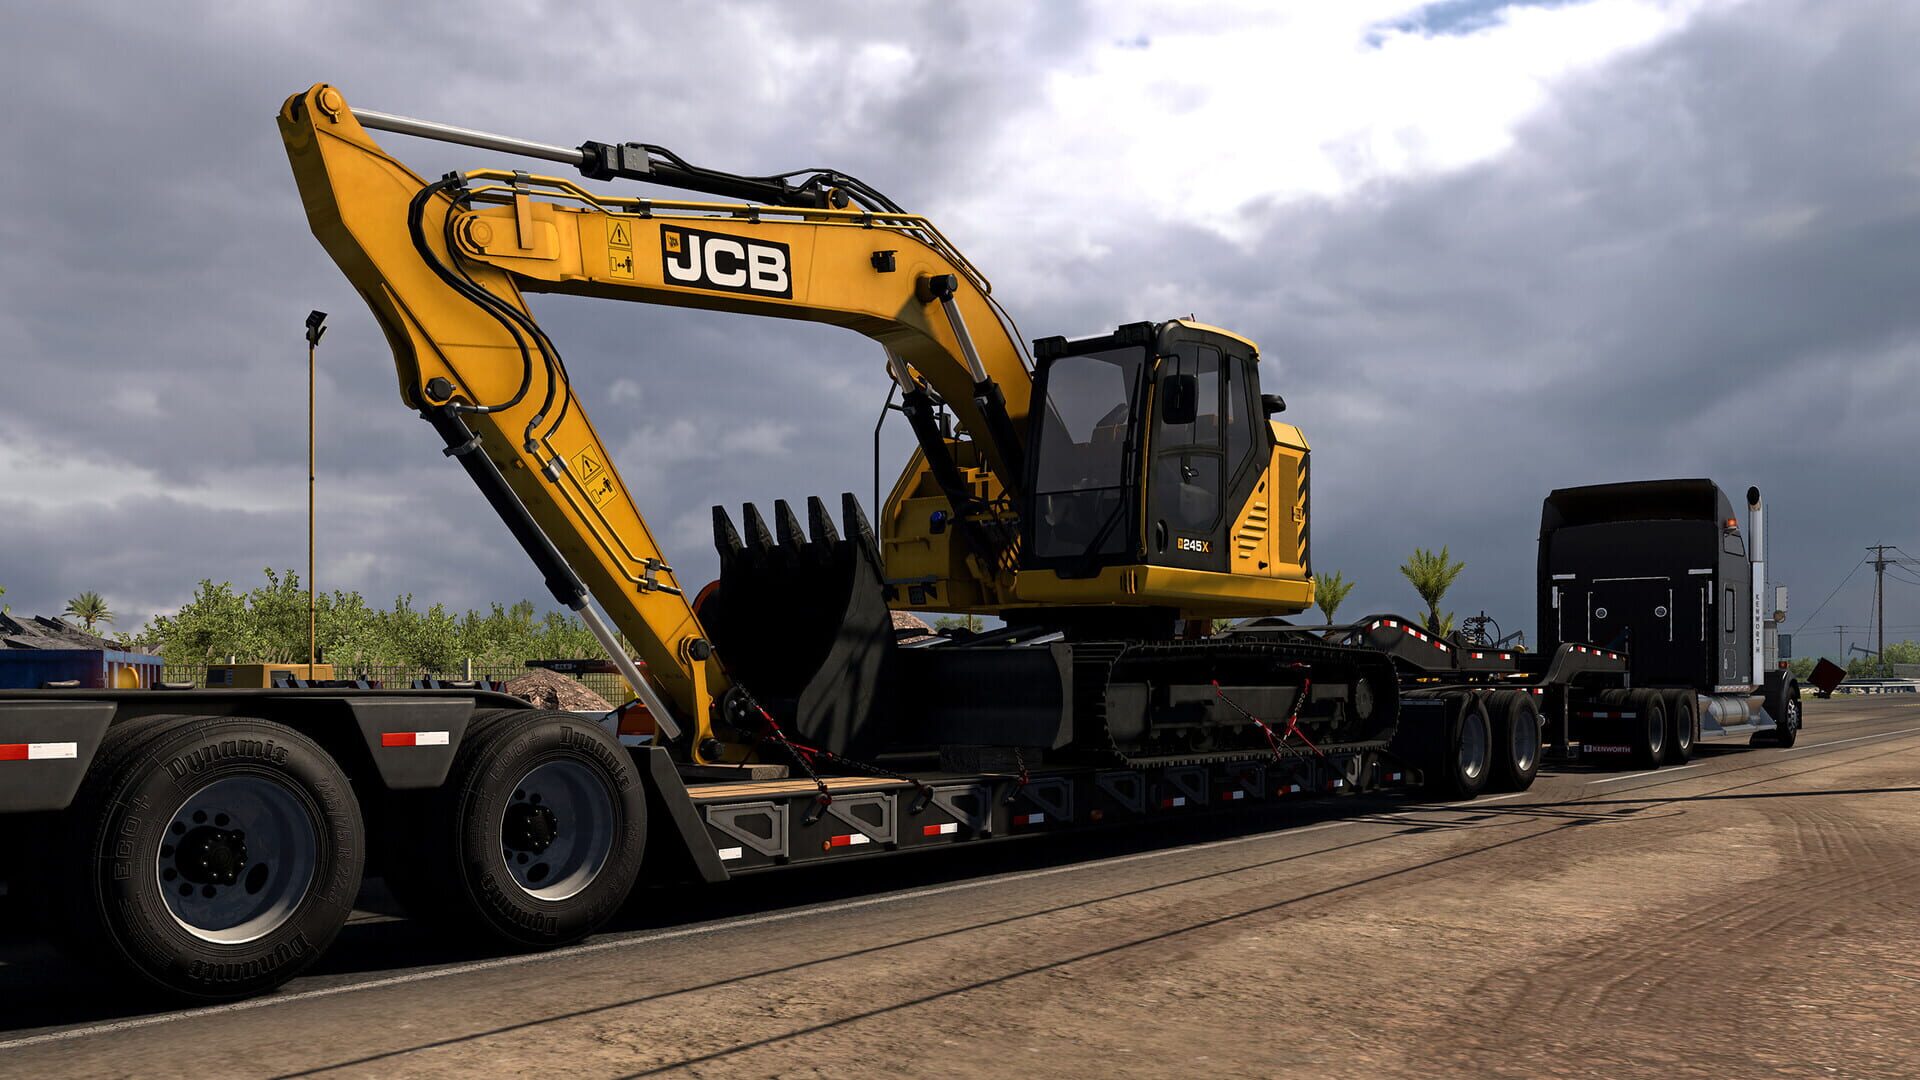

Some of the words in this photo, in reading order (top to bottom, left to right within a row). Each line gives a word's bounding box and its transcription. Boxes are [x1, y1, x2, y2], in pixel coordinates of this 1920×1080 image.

[667, 234, 789, 293] JCB
[1183, 538, 1209, 553] 245X
[164, 738, 289, 784] Dynamix
[559, 725, 631, 792] Dynamix
[1592, 745, 1631, 753] KENWORTH
